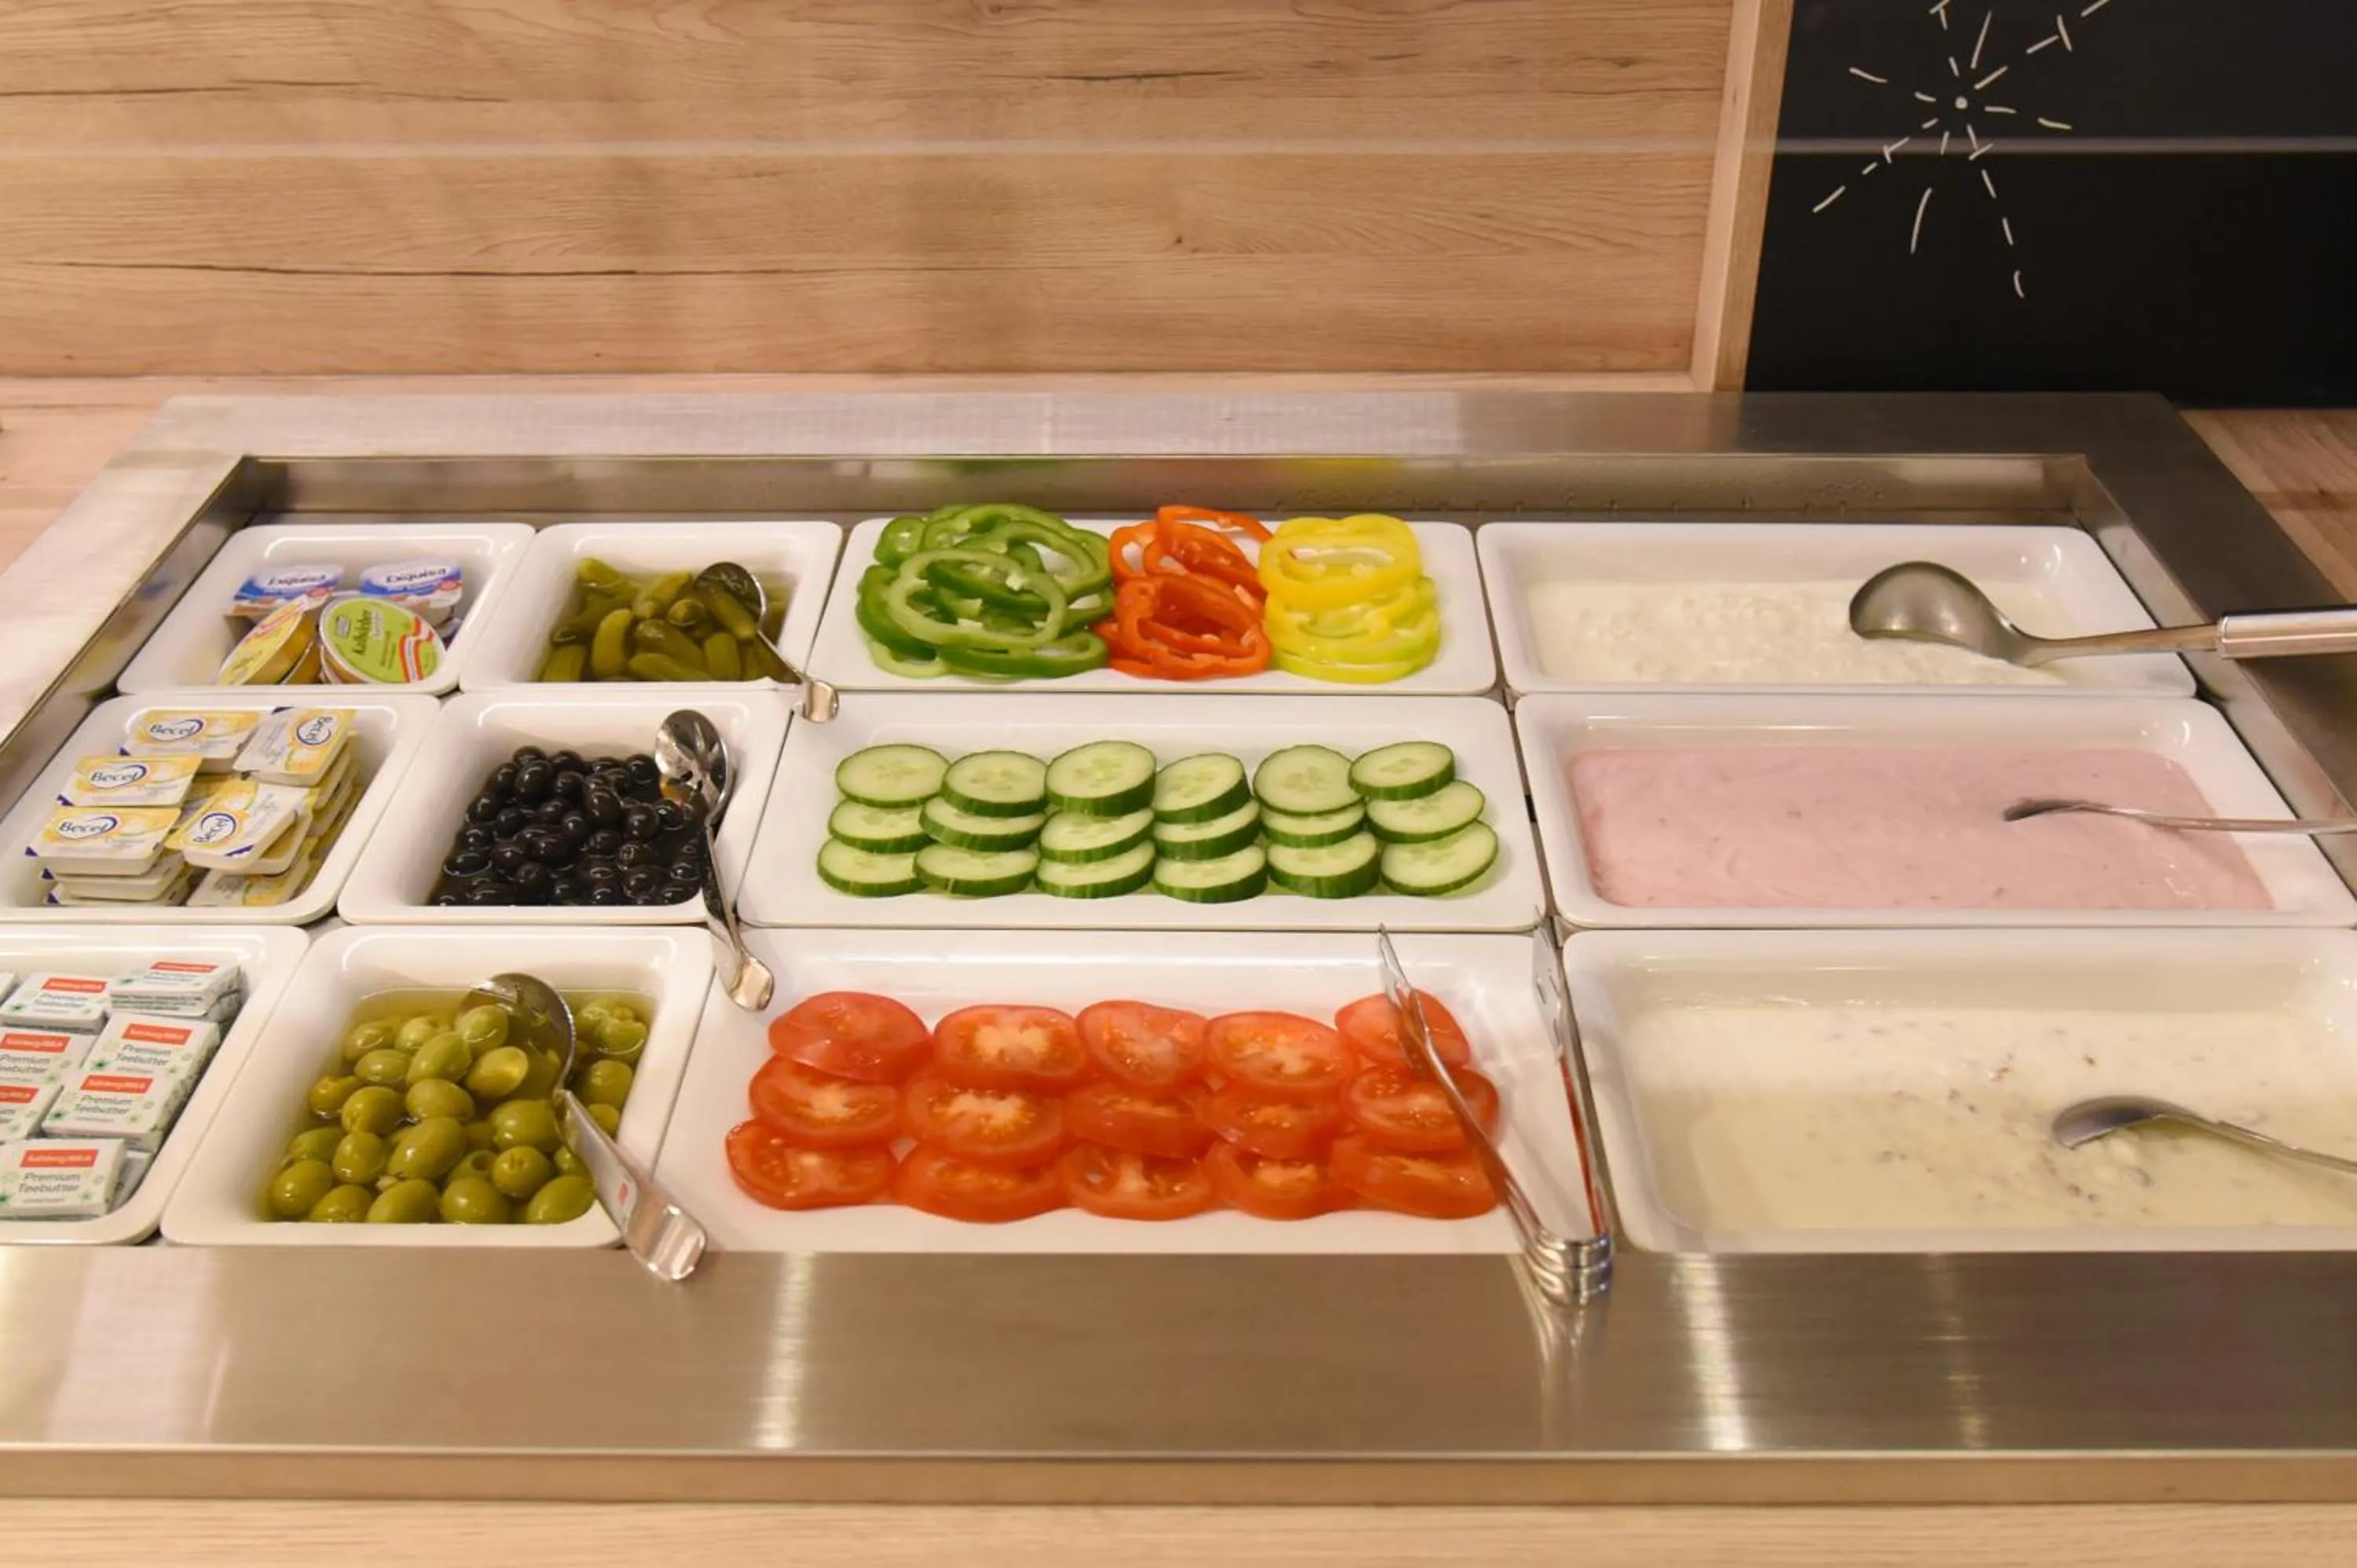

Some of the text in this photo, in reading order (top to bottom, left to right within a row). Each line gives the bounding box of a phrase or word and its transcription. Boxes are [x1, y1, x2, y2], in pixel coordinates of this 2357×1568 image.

[150, 723, 197, 735] Becel
[90, 771, 140, 782] Becel
[59, 821, 110, 833] Becel
[0, 1064, 47, 1075] eebutter
